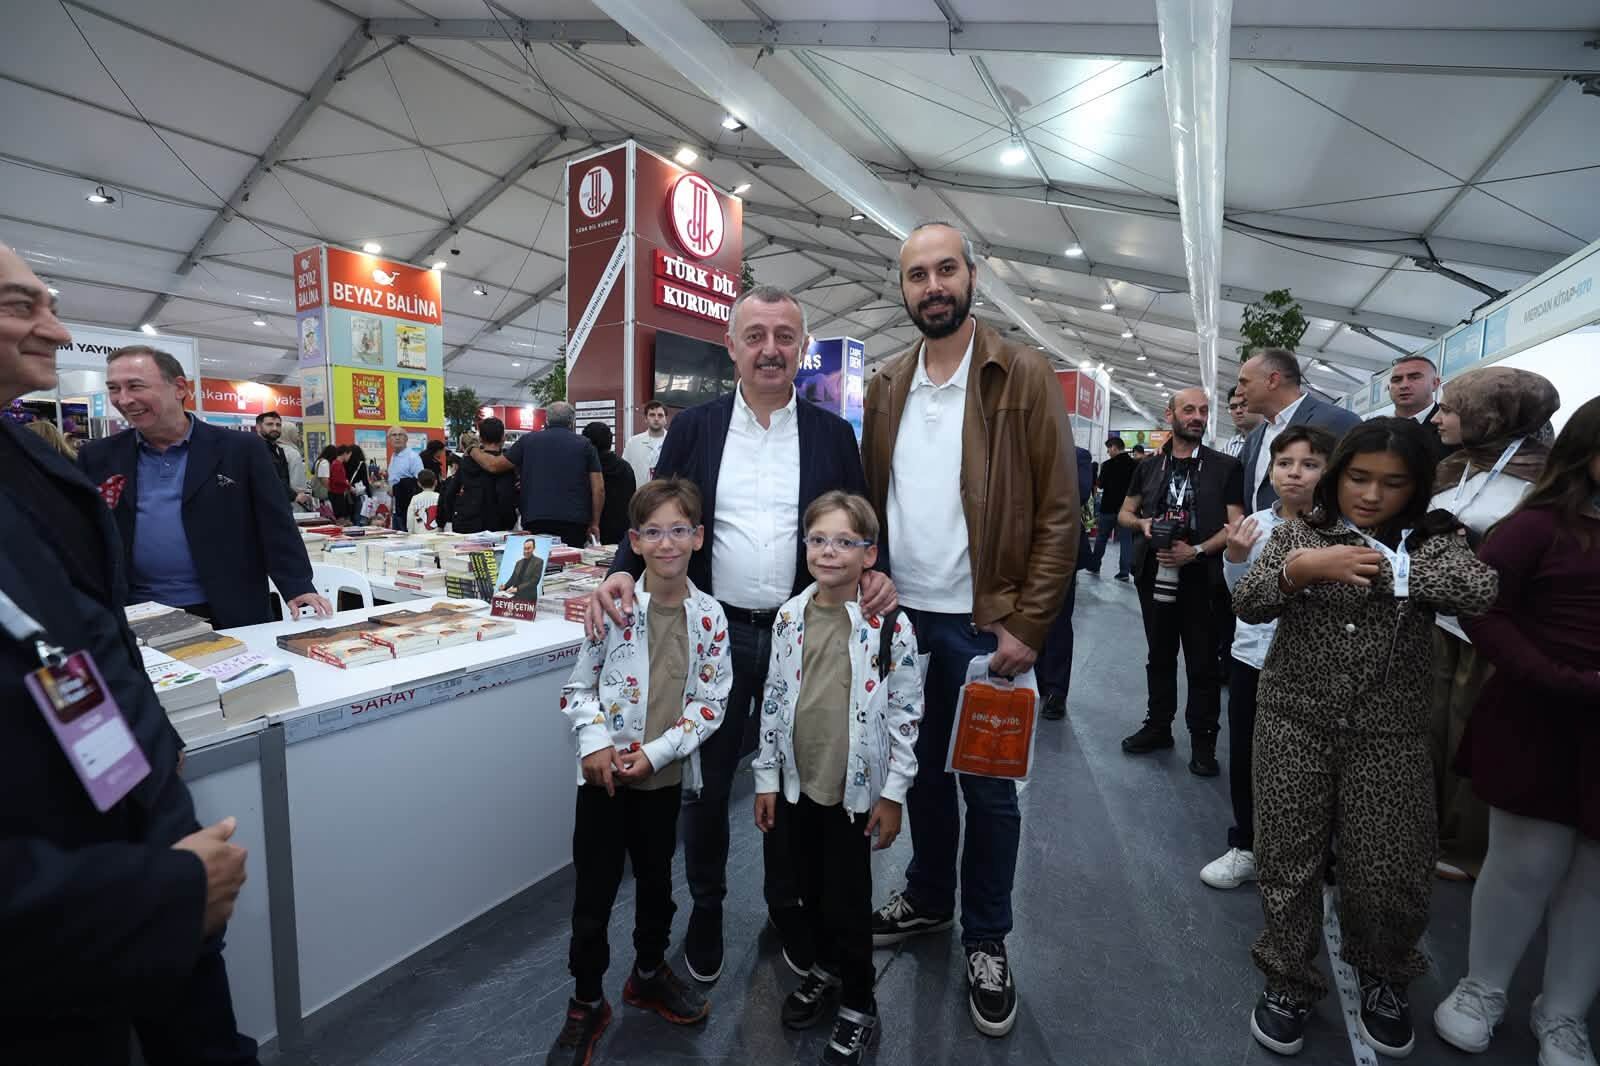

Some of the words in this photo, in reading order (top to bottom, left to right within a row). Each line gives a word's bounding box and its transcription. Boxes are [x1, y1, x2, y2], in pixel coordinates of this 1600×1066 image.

[299, 270, 317, 288] BEYAZ
[664, 255, 709, 288] TÜRK
[713, 273, 737, 298] DİL
[333, 281, 383, 308] BEYAZ
[386, 293, 438, 318] BALİNA
[664, 285, 730, 321] KURUMU
[351, 688, 416, 715] SARAY
